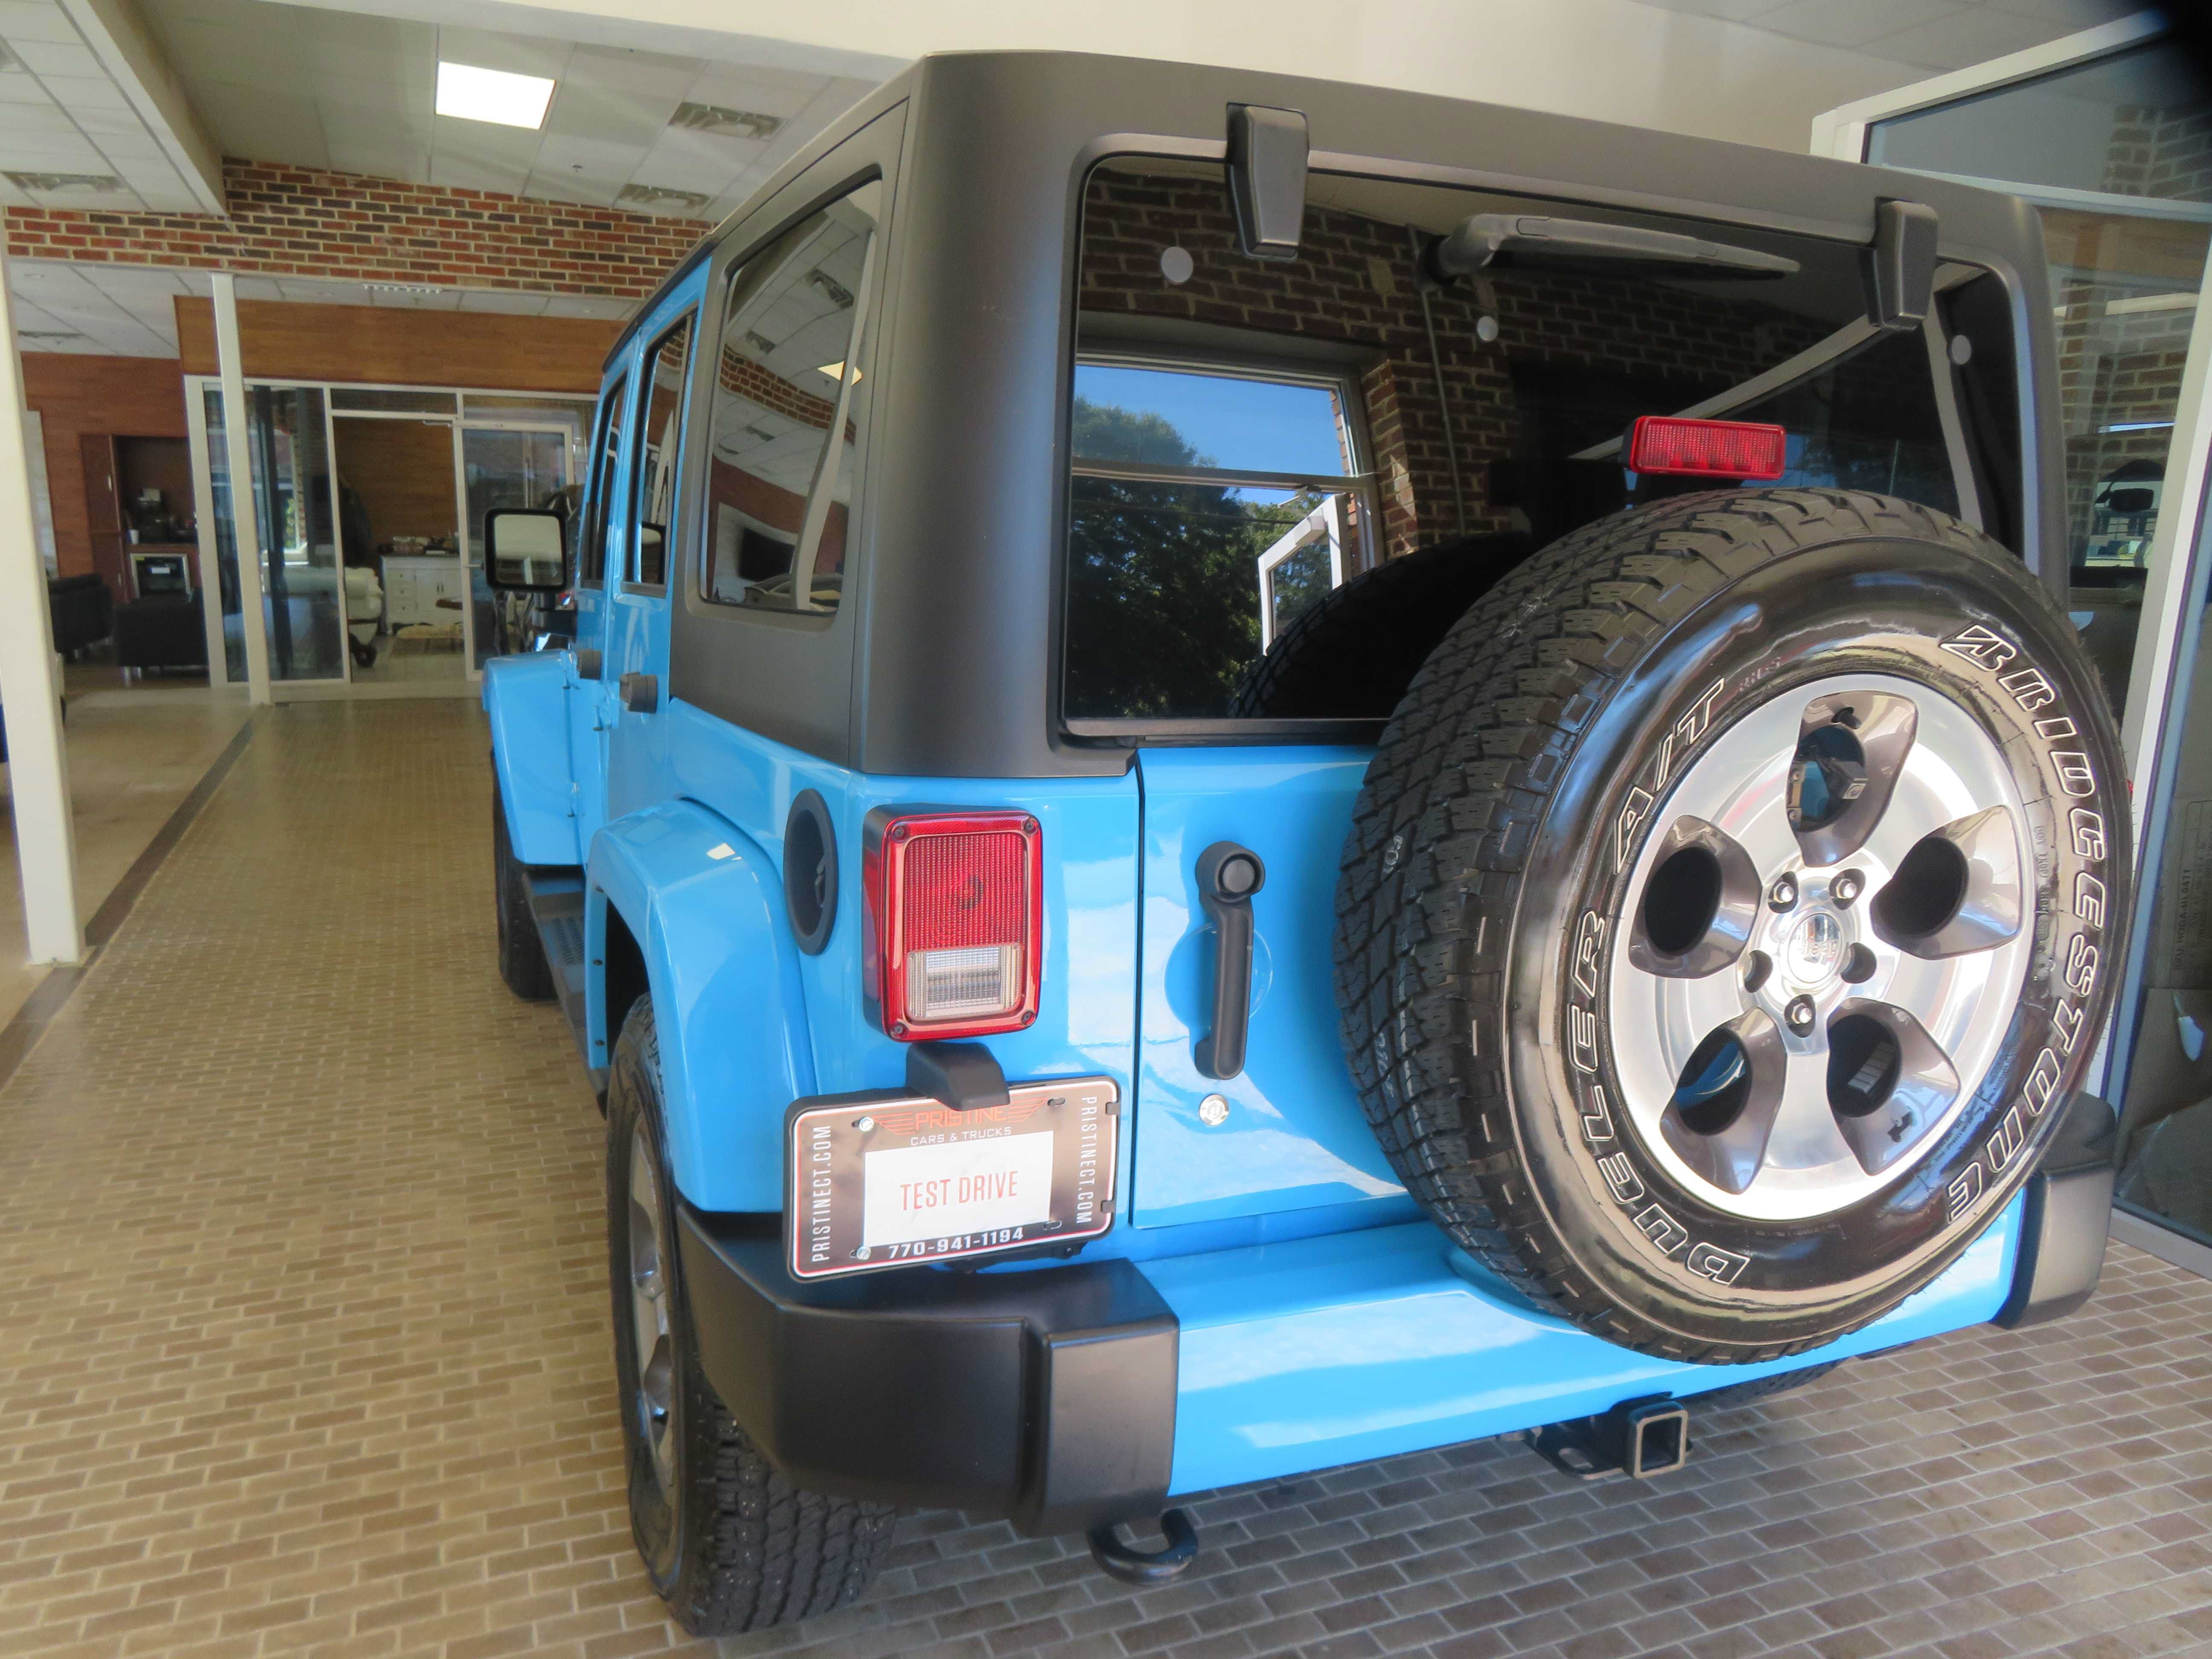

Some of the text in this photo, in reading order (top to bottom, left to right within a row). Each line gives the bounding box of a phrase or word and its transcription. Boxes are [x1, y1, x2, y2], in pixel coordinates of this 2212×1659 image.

[1938, 624, 2106, 1224] BRIDGESTONE
[1569, 677, 1751, 1285] DUELER A/T
[911, 1134, 945, 1146] CARS
[962, 1126, 1012, 1140] TRUCKS
[916, 1106, 1006, 1130] PRISTINE
[1076, 1096, 1097, 1224] PRISTINECT.COM
[812, 1125, 831, 1263] PRISTINECT.COM
[900, 1170, 1018, 1211] TEST DRIVE
[888, 1227, 1024, 1259] 770-941-1194
